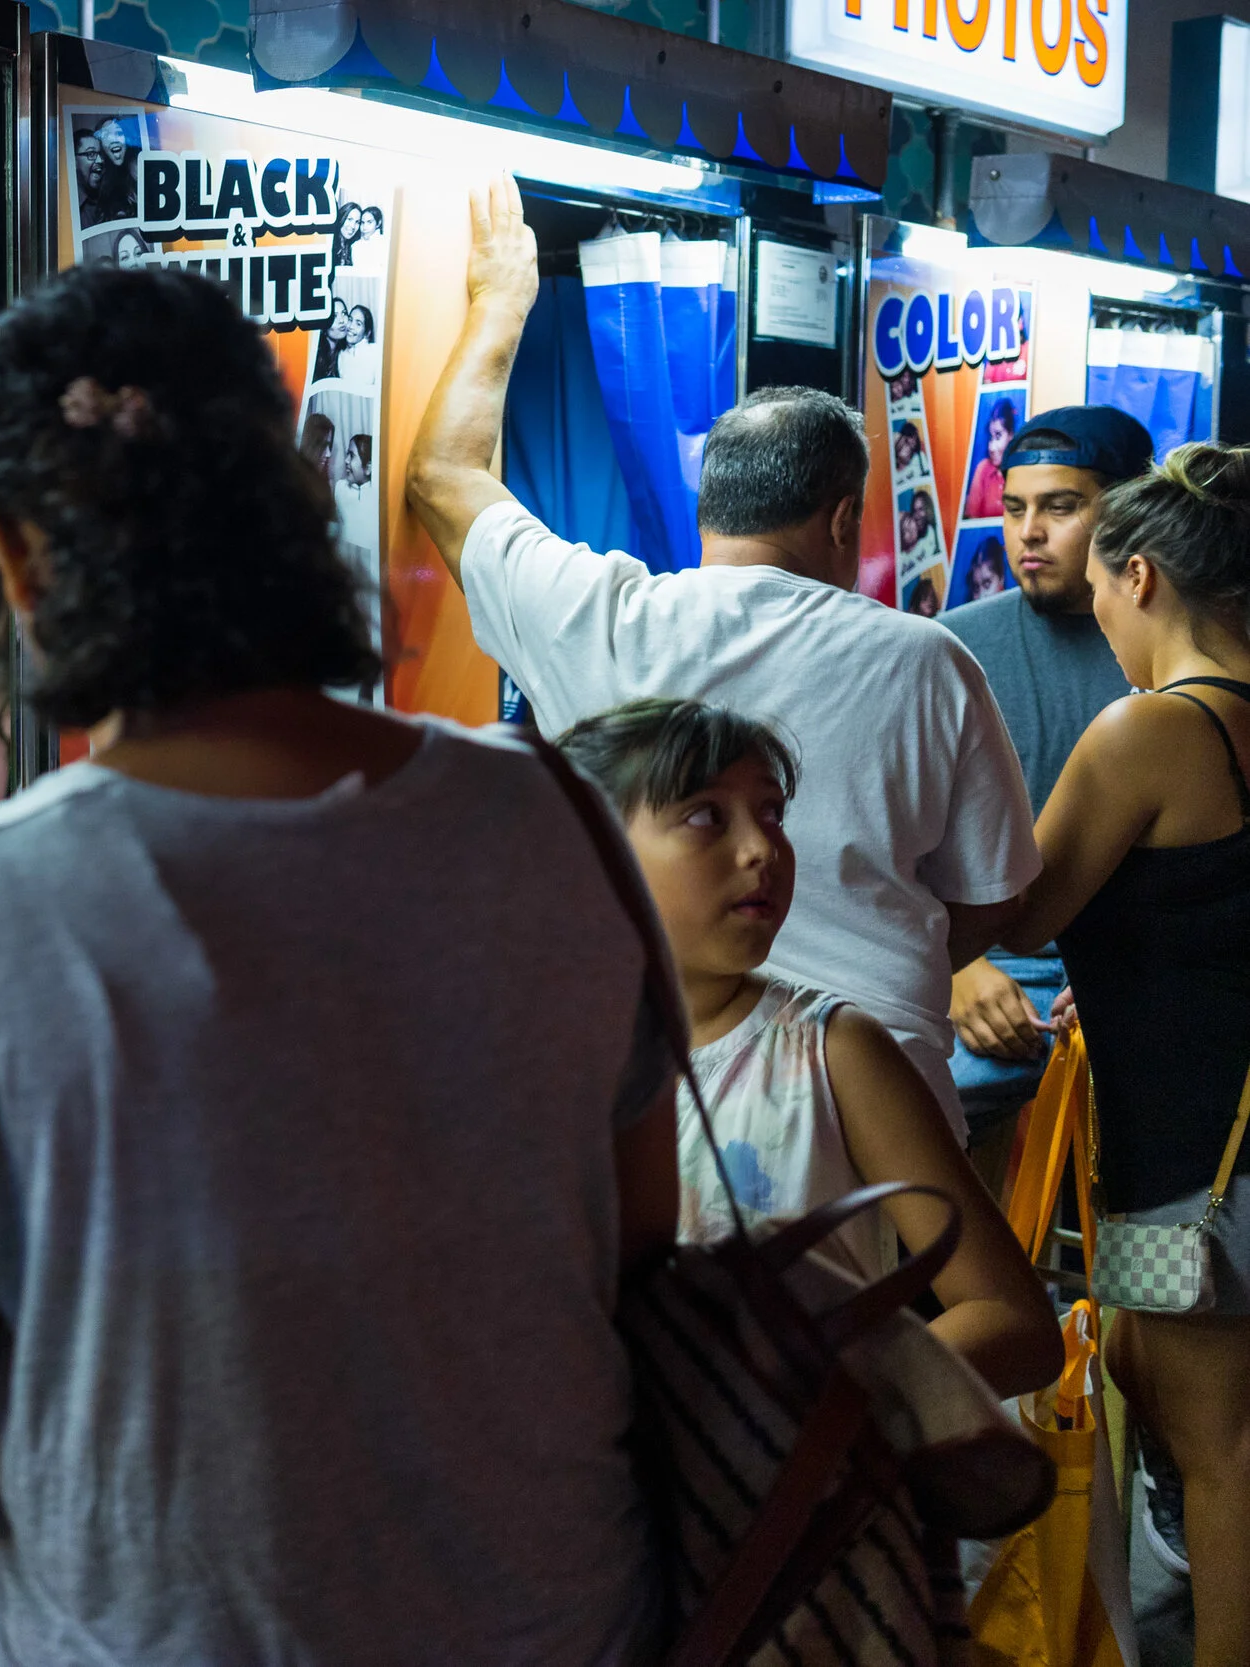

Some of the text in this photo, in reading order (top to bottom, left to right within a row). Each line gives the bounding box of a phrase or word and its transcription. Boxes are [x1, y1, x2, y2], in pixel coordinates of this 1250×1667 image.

[845, 0, 1109, 88] OTOS
[143, 157, 331, 222] BLACK
[232, 222, 248, 248] &
[145, 252, 327, 316] HITE
[875, 287, 1016, 370] COLOR
